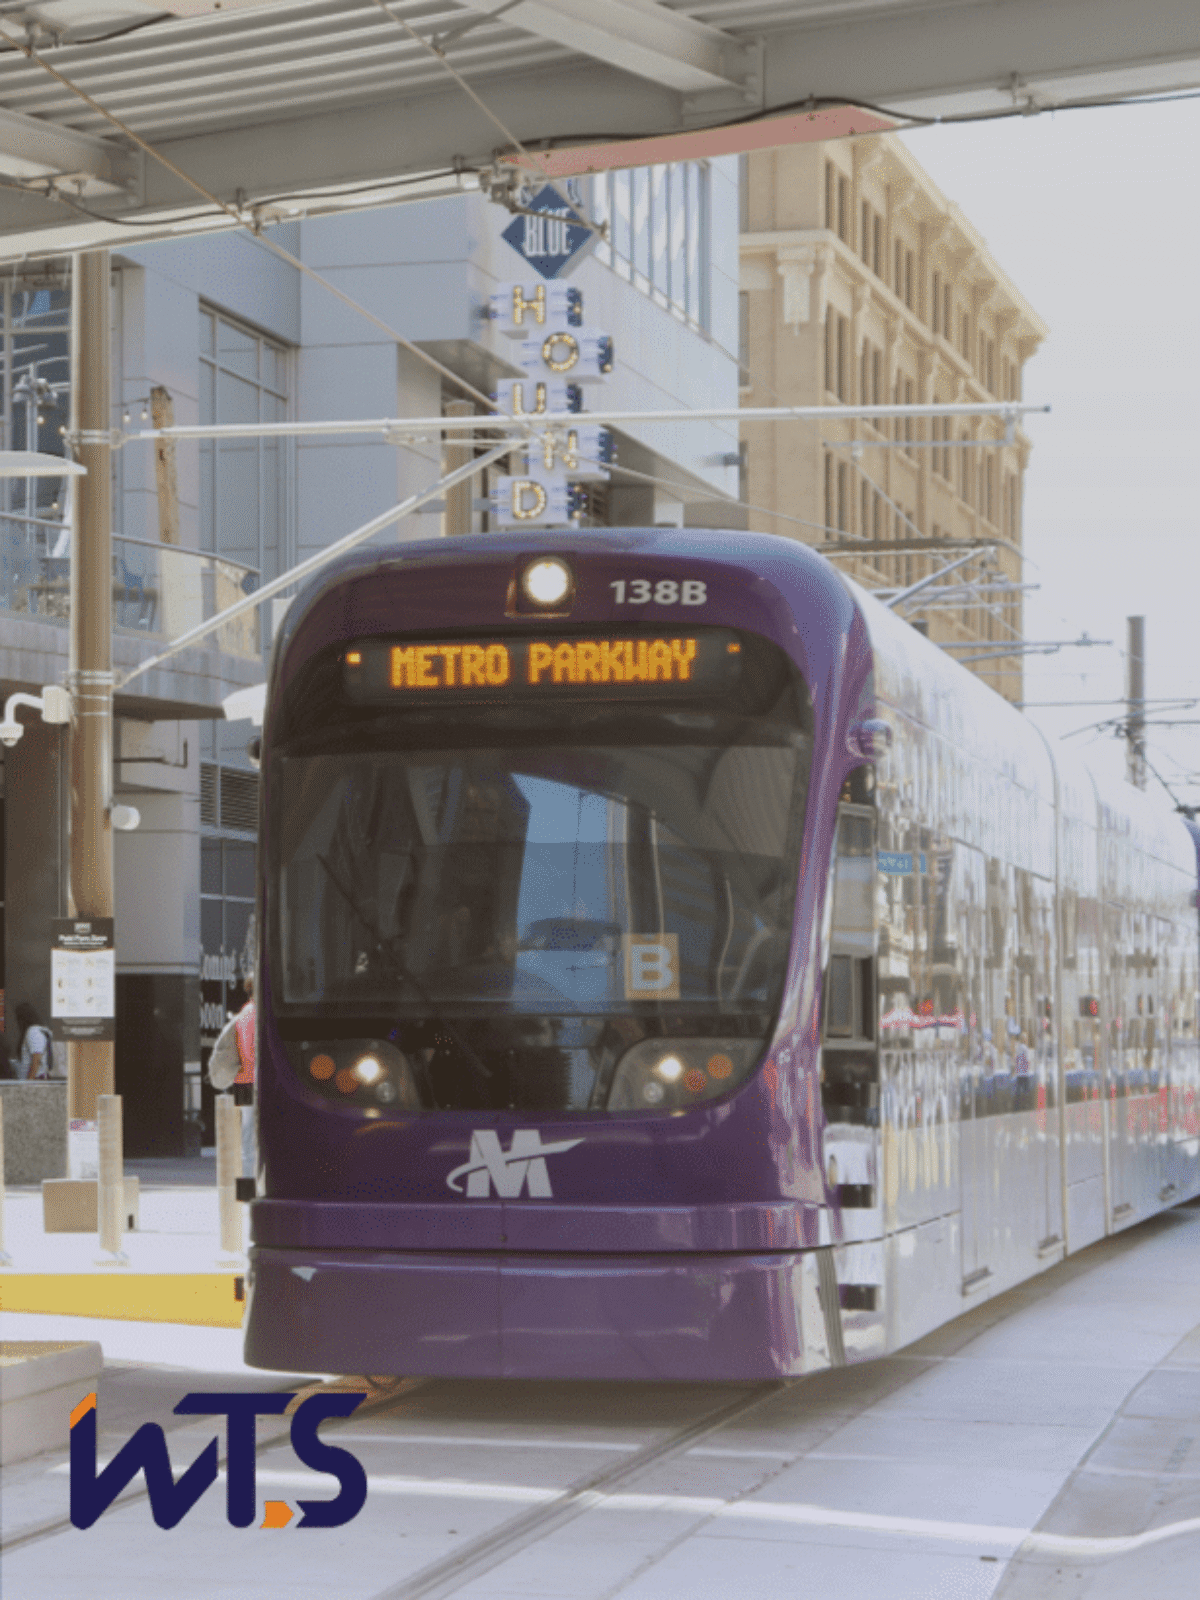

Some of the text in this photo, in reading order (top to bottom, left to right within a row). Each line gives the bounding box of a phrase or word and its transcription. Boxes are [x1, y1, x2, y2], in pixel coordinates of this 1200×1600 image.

[521, 206, 571, 257] BLUE
[609, 579, 708, 606] 138B
[390, 639, 696, 688] METRO PARKWAY
[630, 944, 672, 990] B
